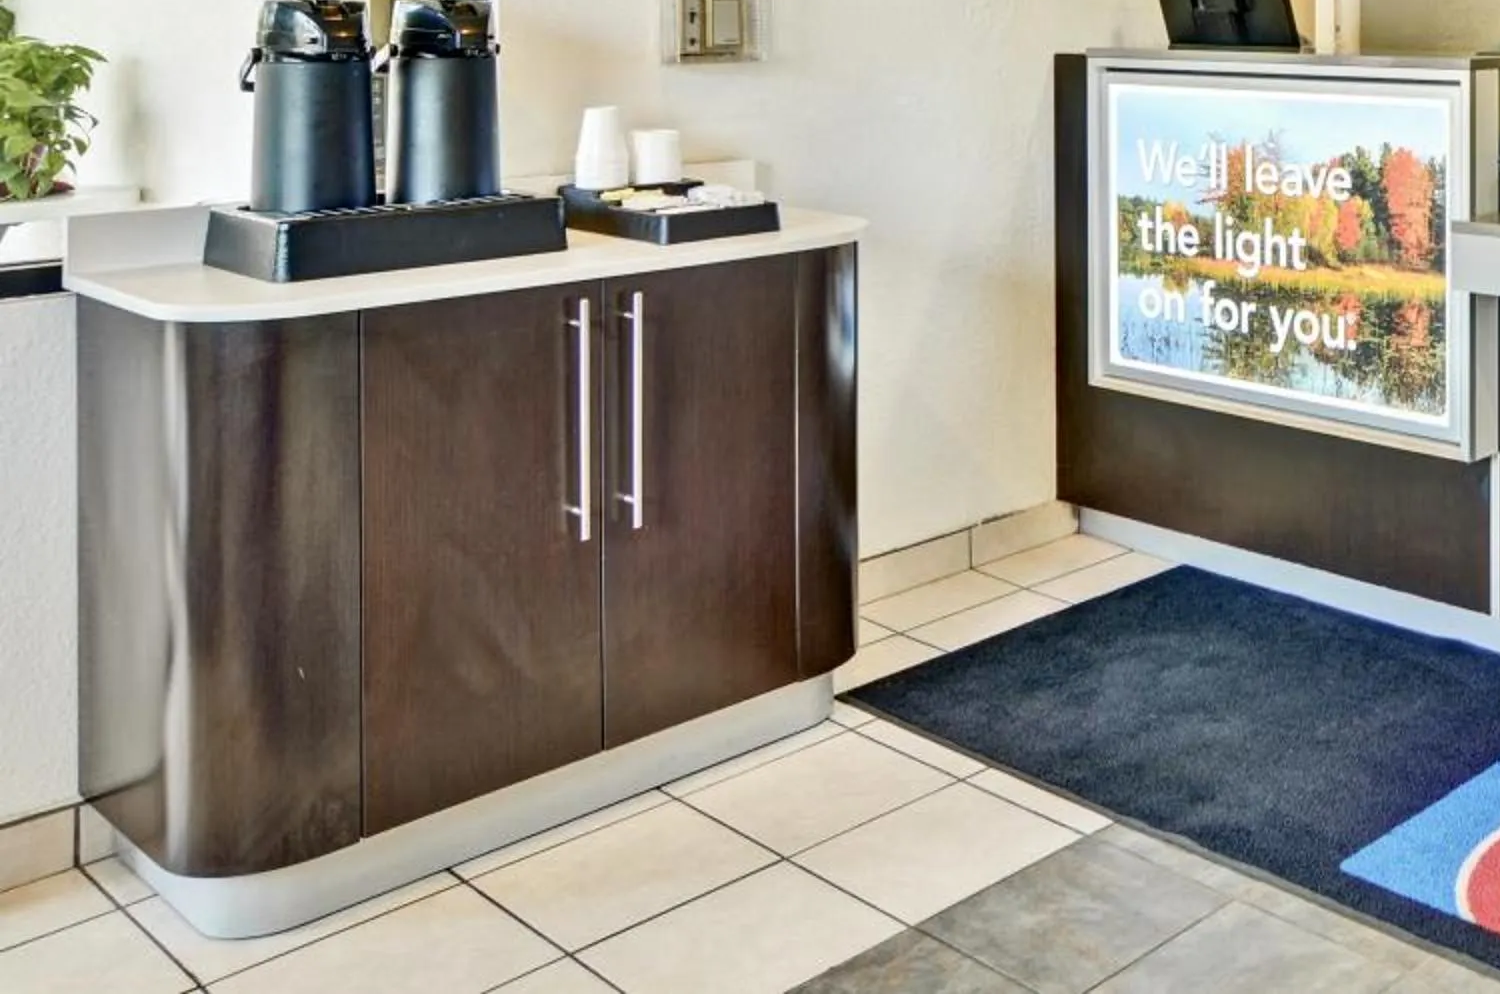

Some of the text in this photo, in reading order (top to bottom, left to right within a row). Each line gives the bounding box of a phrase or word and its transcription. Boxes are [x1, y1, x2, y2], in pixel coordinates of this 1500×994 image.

[1136, 139, 1353, 201] We'll leave
[1137, 206, 1307, 277] the light
[1138, 286, 1185, 323] on
[1200, 281, 1256, 333] for
